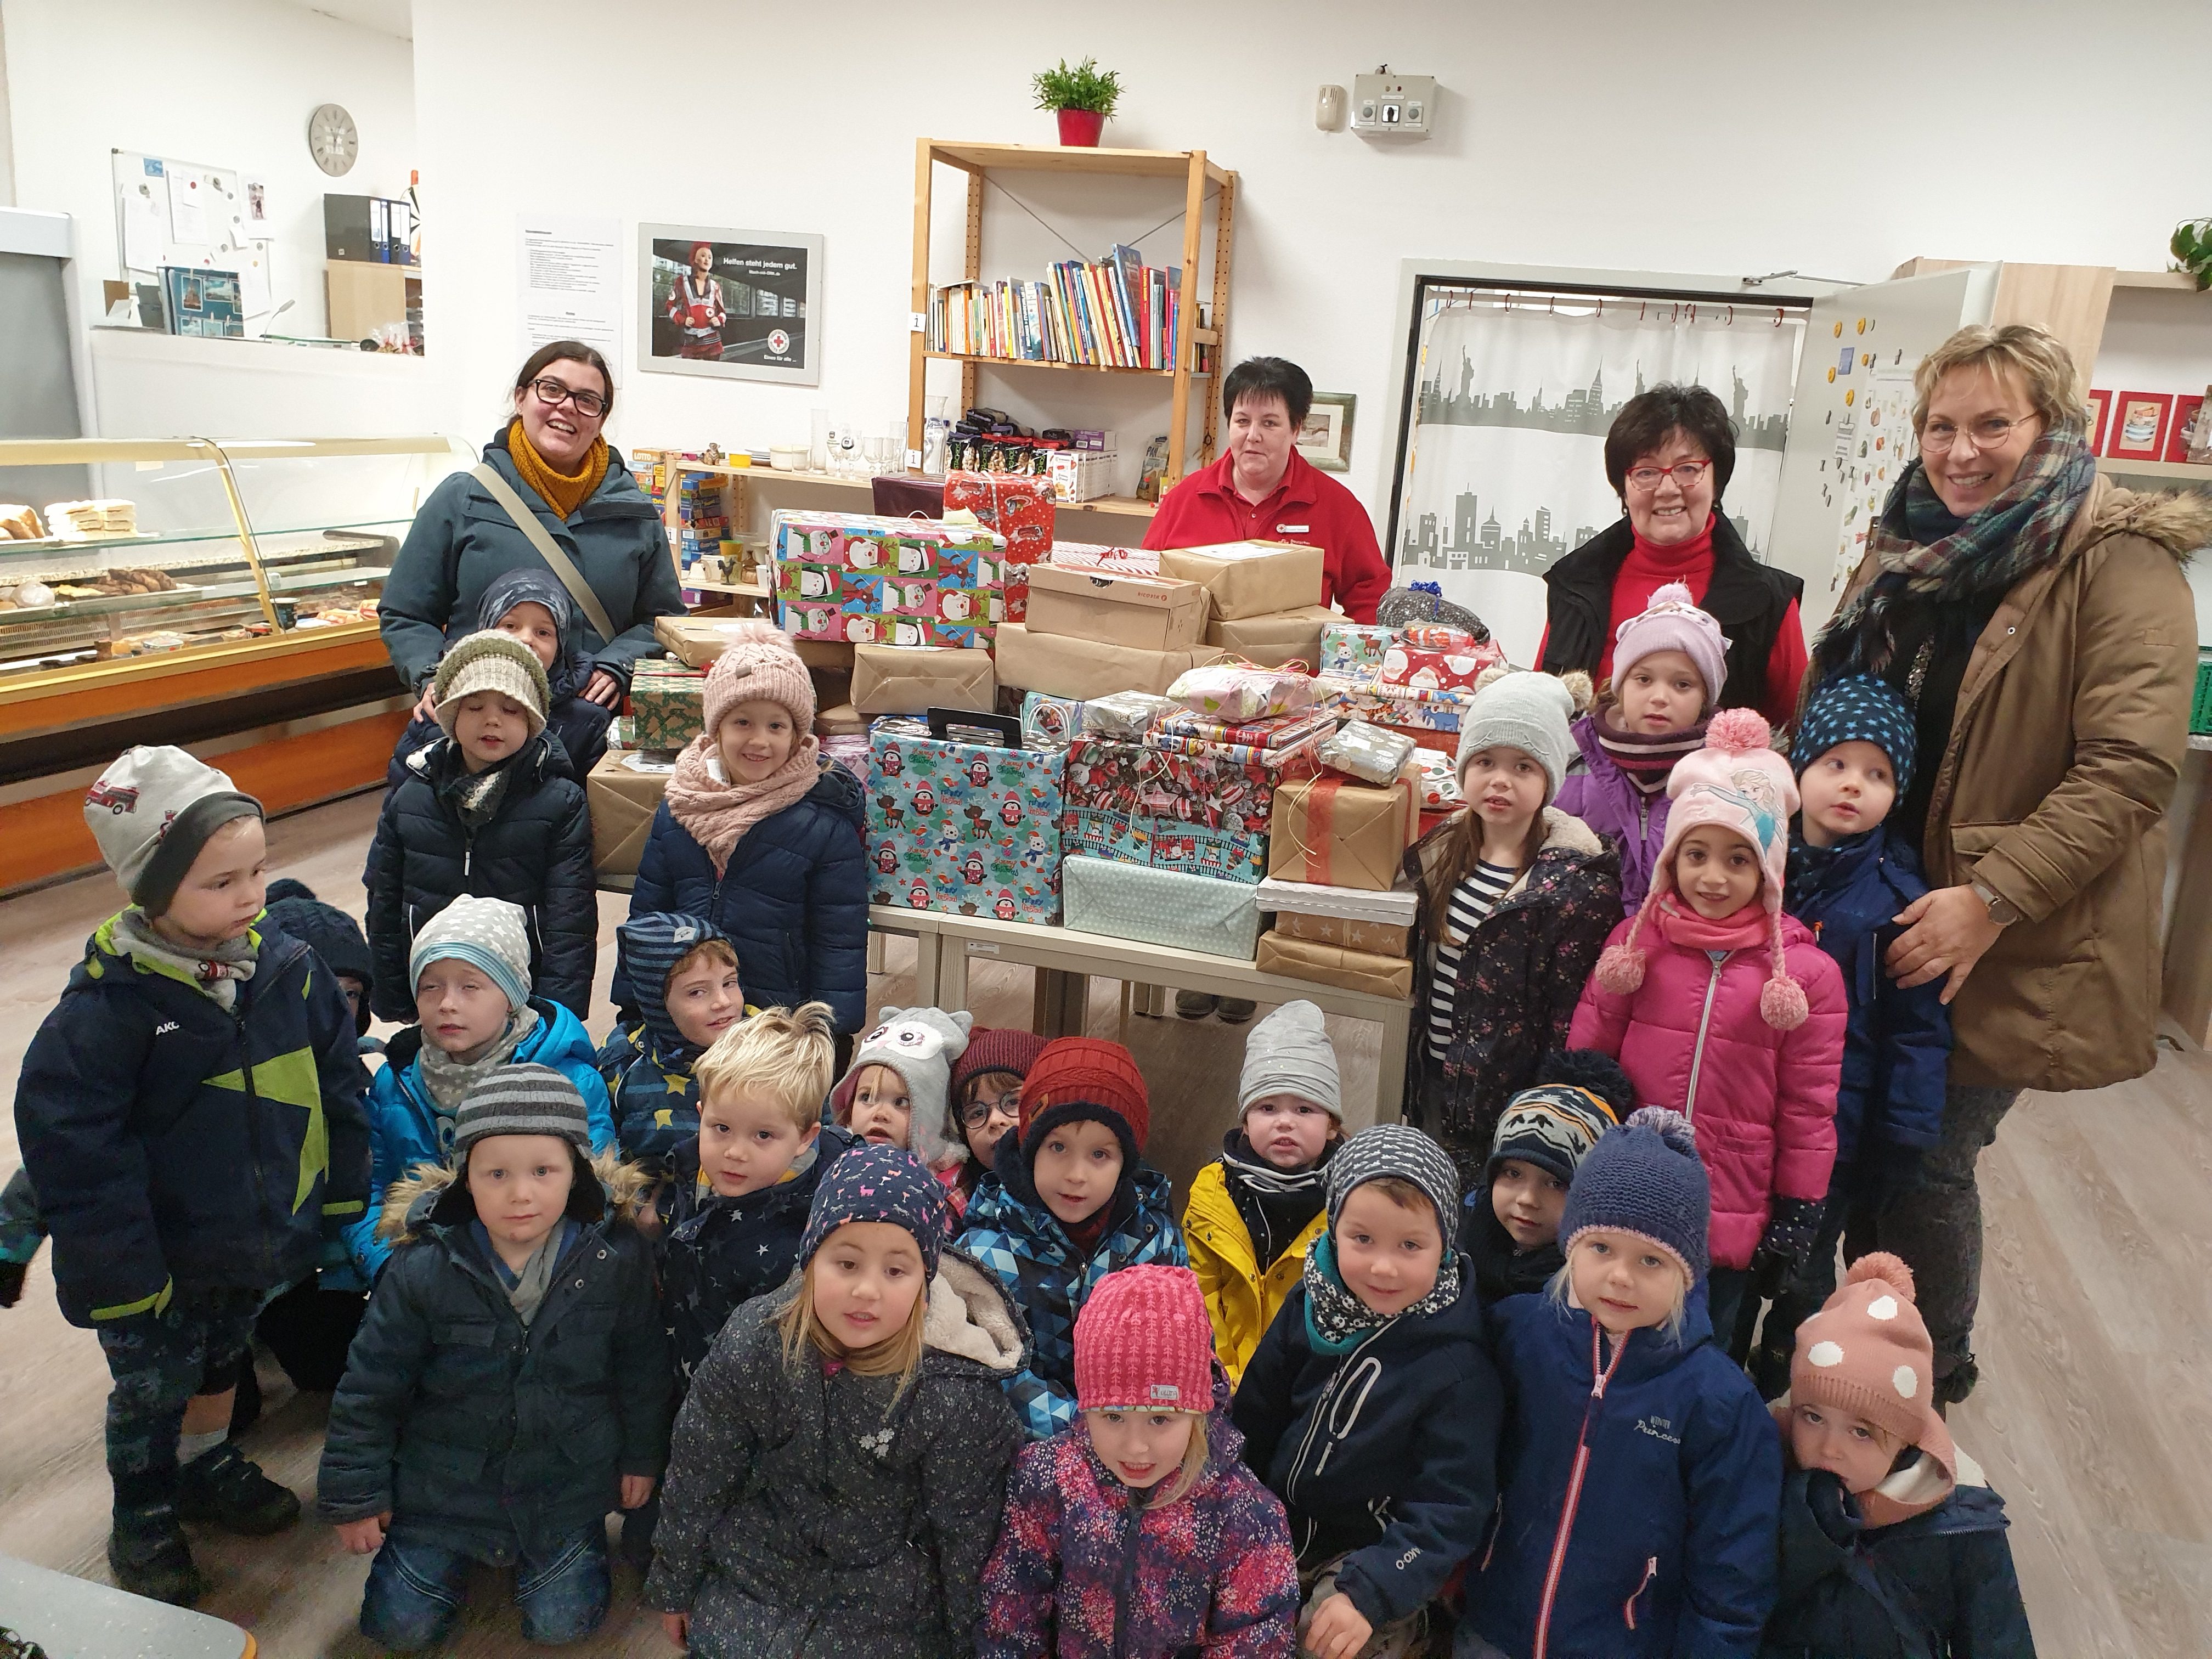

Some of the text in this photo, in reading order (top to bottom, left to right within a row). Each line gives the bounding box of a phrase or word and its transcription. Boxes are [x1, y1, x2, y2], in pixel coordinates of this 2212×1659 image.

[723, 257, 744, 266] Helfen
[763, 261, 783, 269] jedem
[634, 452, 651, 460] LOTTO
[911, 455, 916, 464] 1
[668, 532, 672, 540] 1
